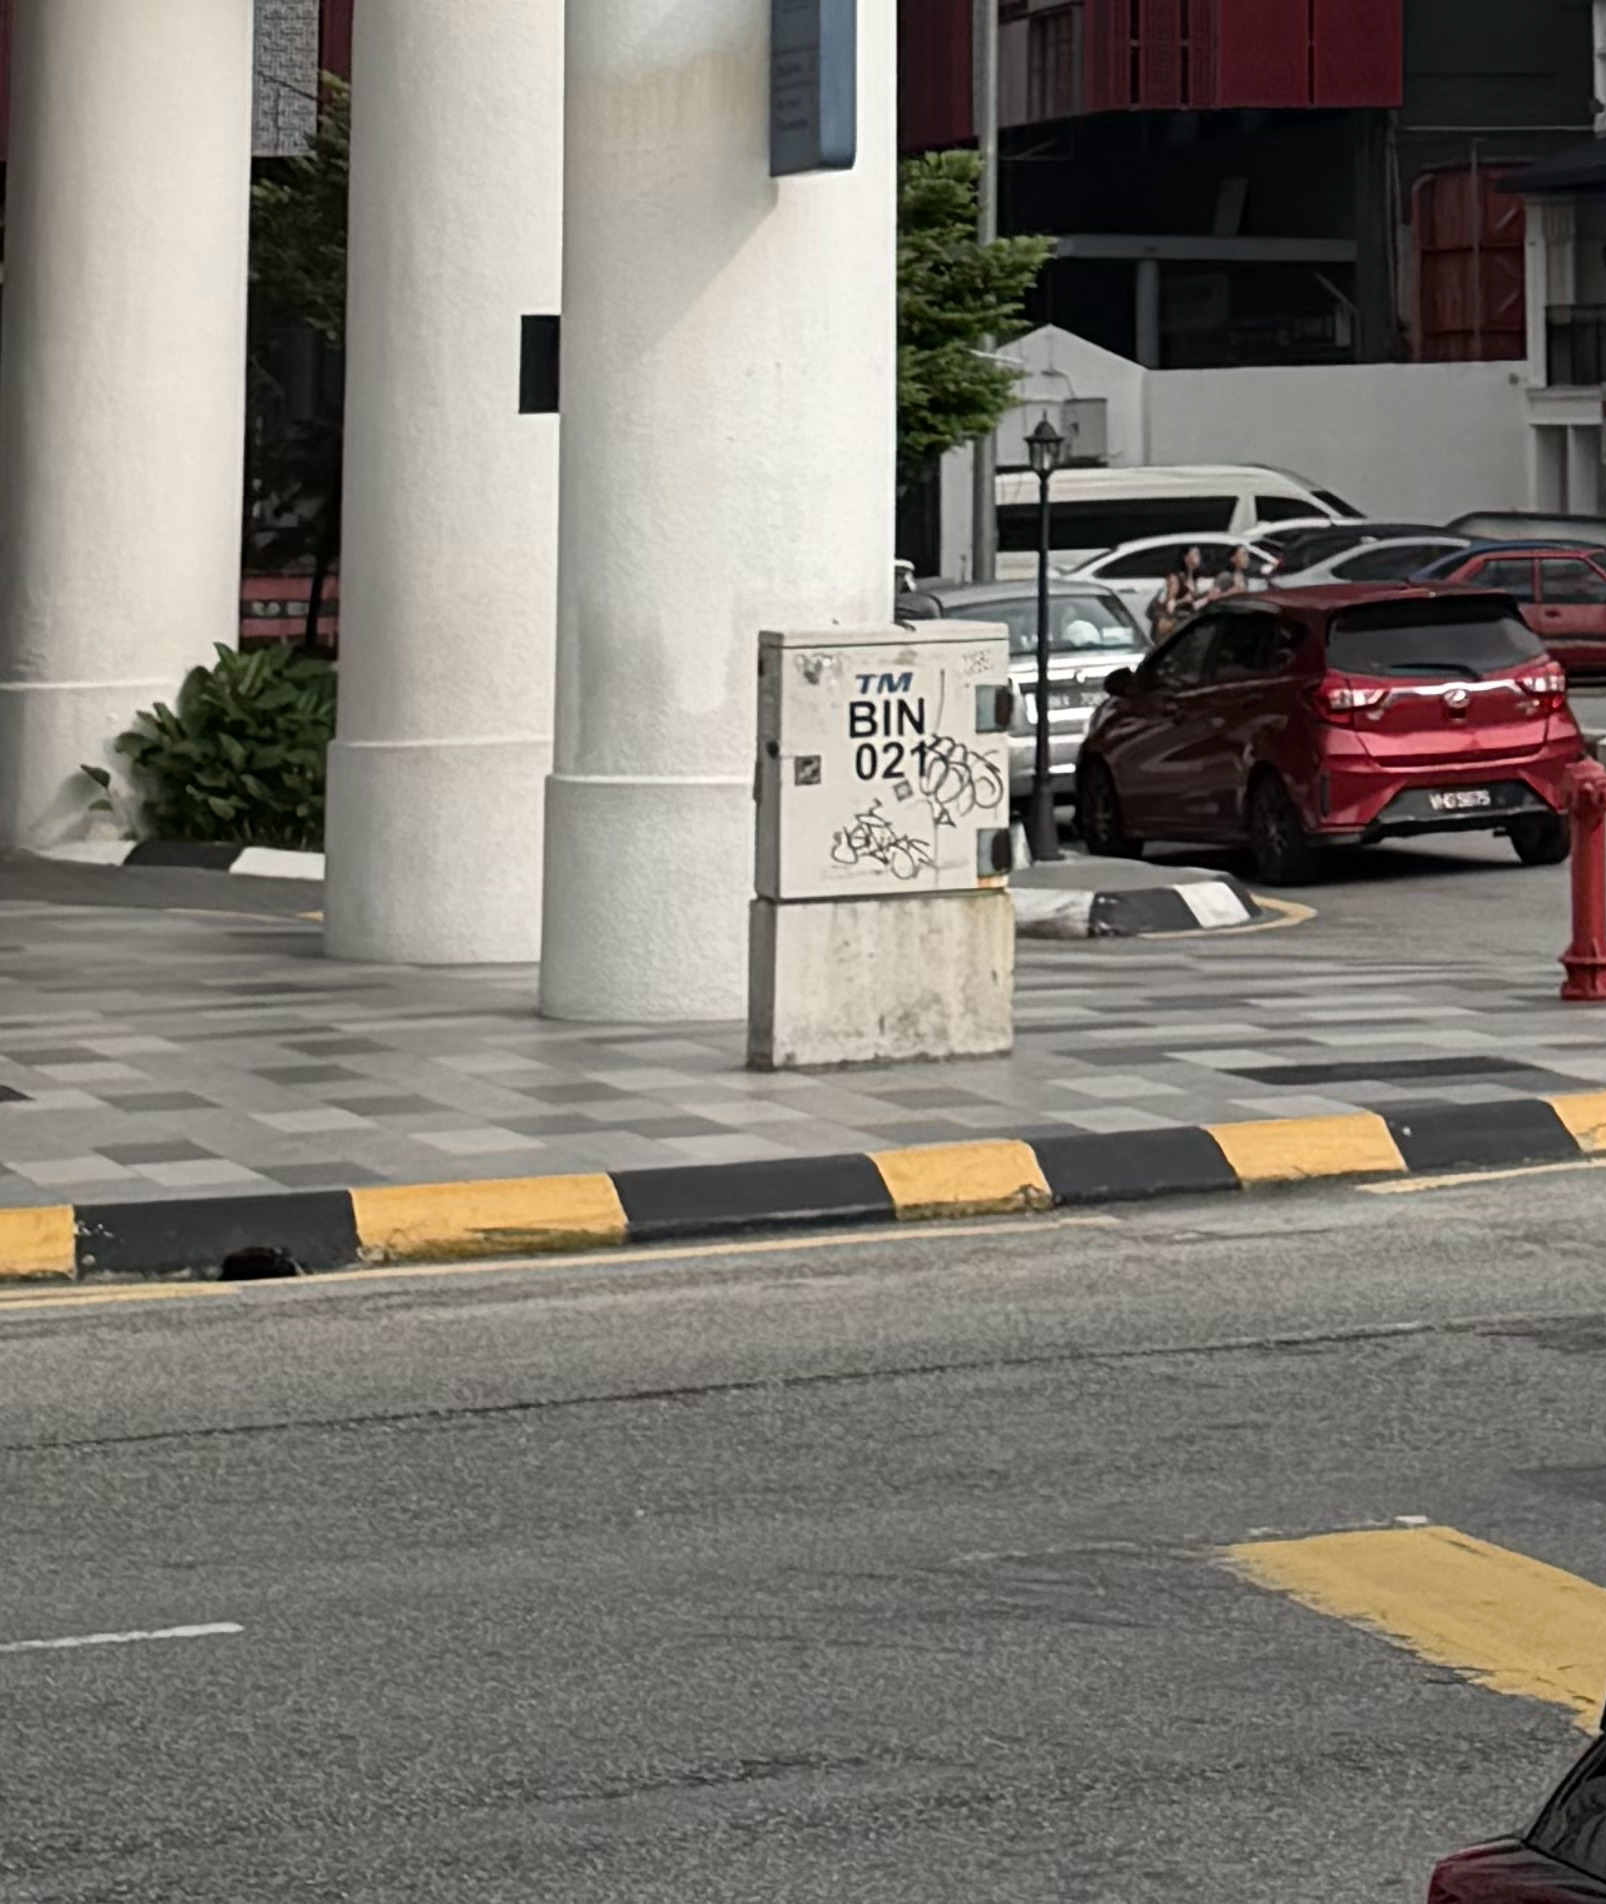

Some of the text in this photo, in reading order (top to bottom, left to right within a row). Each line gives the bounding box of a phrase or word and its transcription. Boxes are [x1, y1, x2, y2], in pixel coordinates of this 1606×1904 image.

[856, 673, 913, 694] TM
[849, 697, 925, 738] BIN
[855, 741, 927, 781] 021
